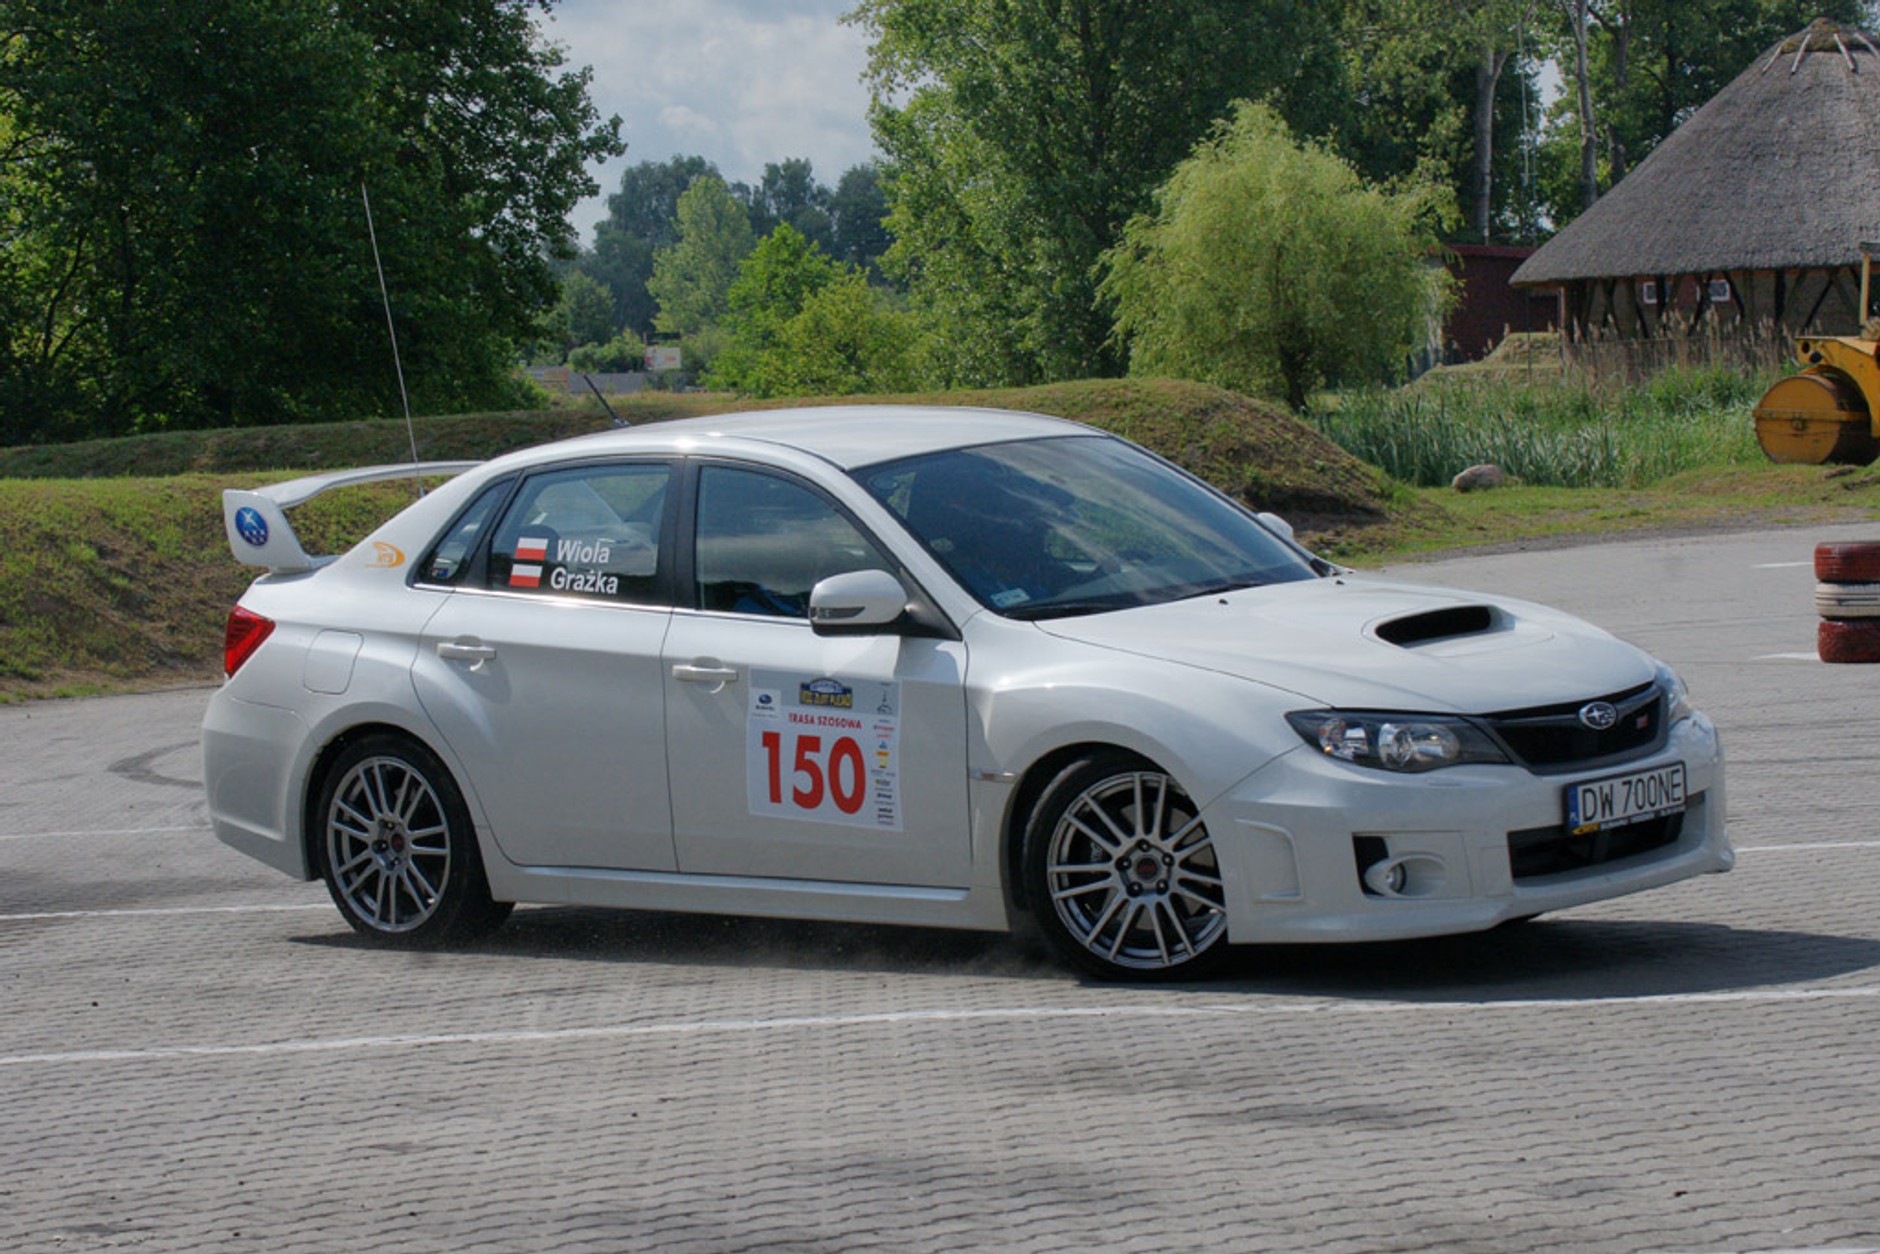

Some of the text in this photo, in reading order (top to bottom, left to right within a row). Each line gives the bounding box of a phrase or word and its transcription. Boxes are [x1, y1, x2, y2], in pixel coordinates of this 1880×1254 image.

[557, 538, 610, 563] Wiola
[550, 567, 619, 594] Grażka
[788, 712, 815, 725] TRASA
[817, 715, 862, 730] SZOSOWA
[762, 731, 866, 815] 150
[1582, 769, 1681, 821] DW 700NE
